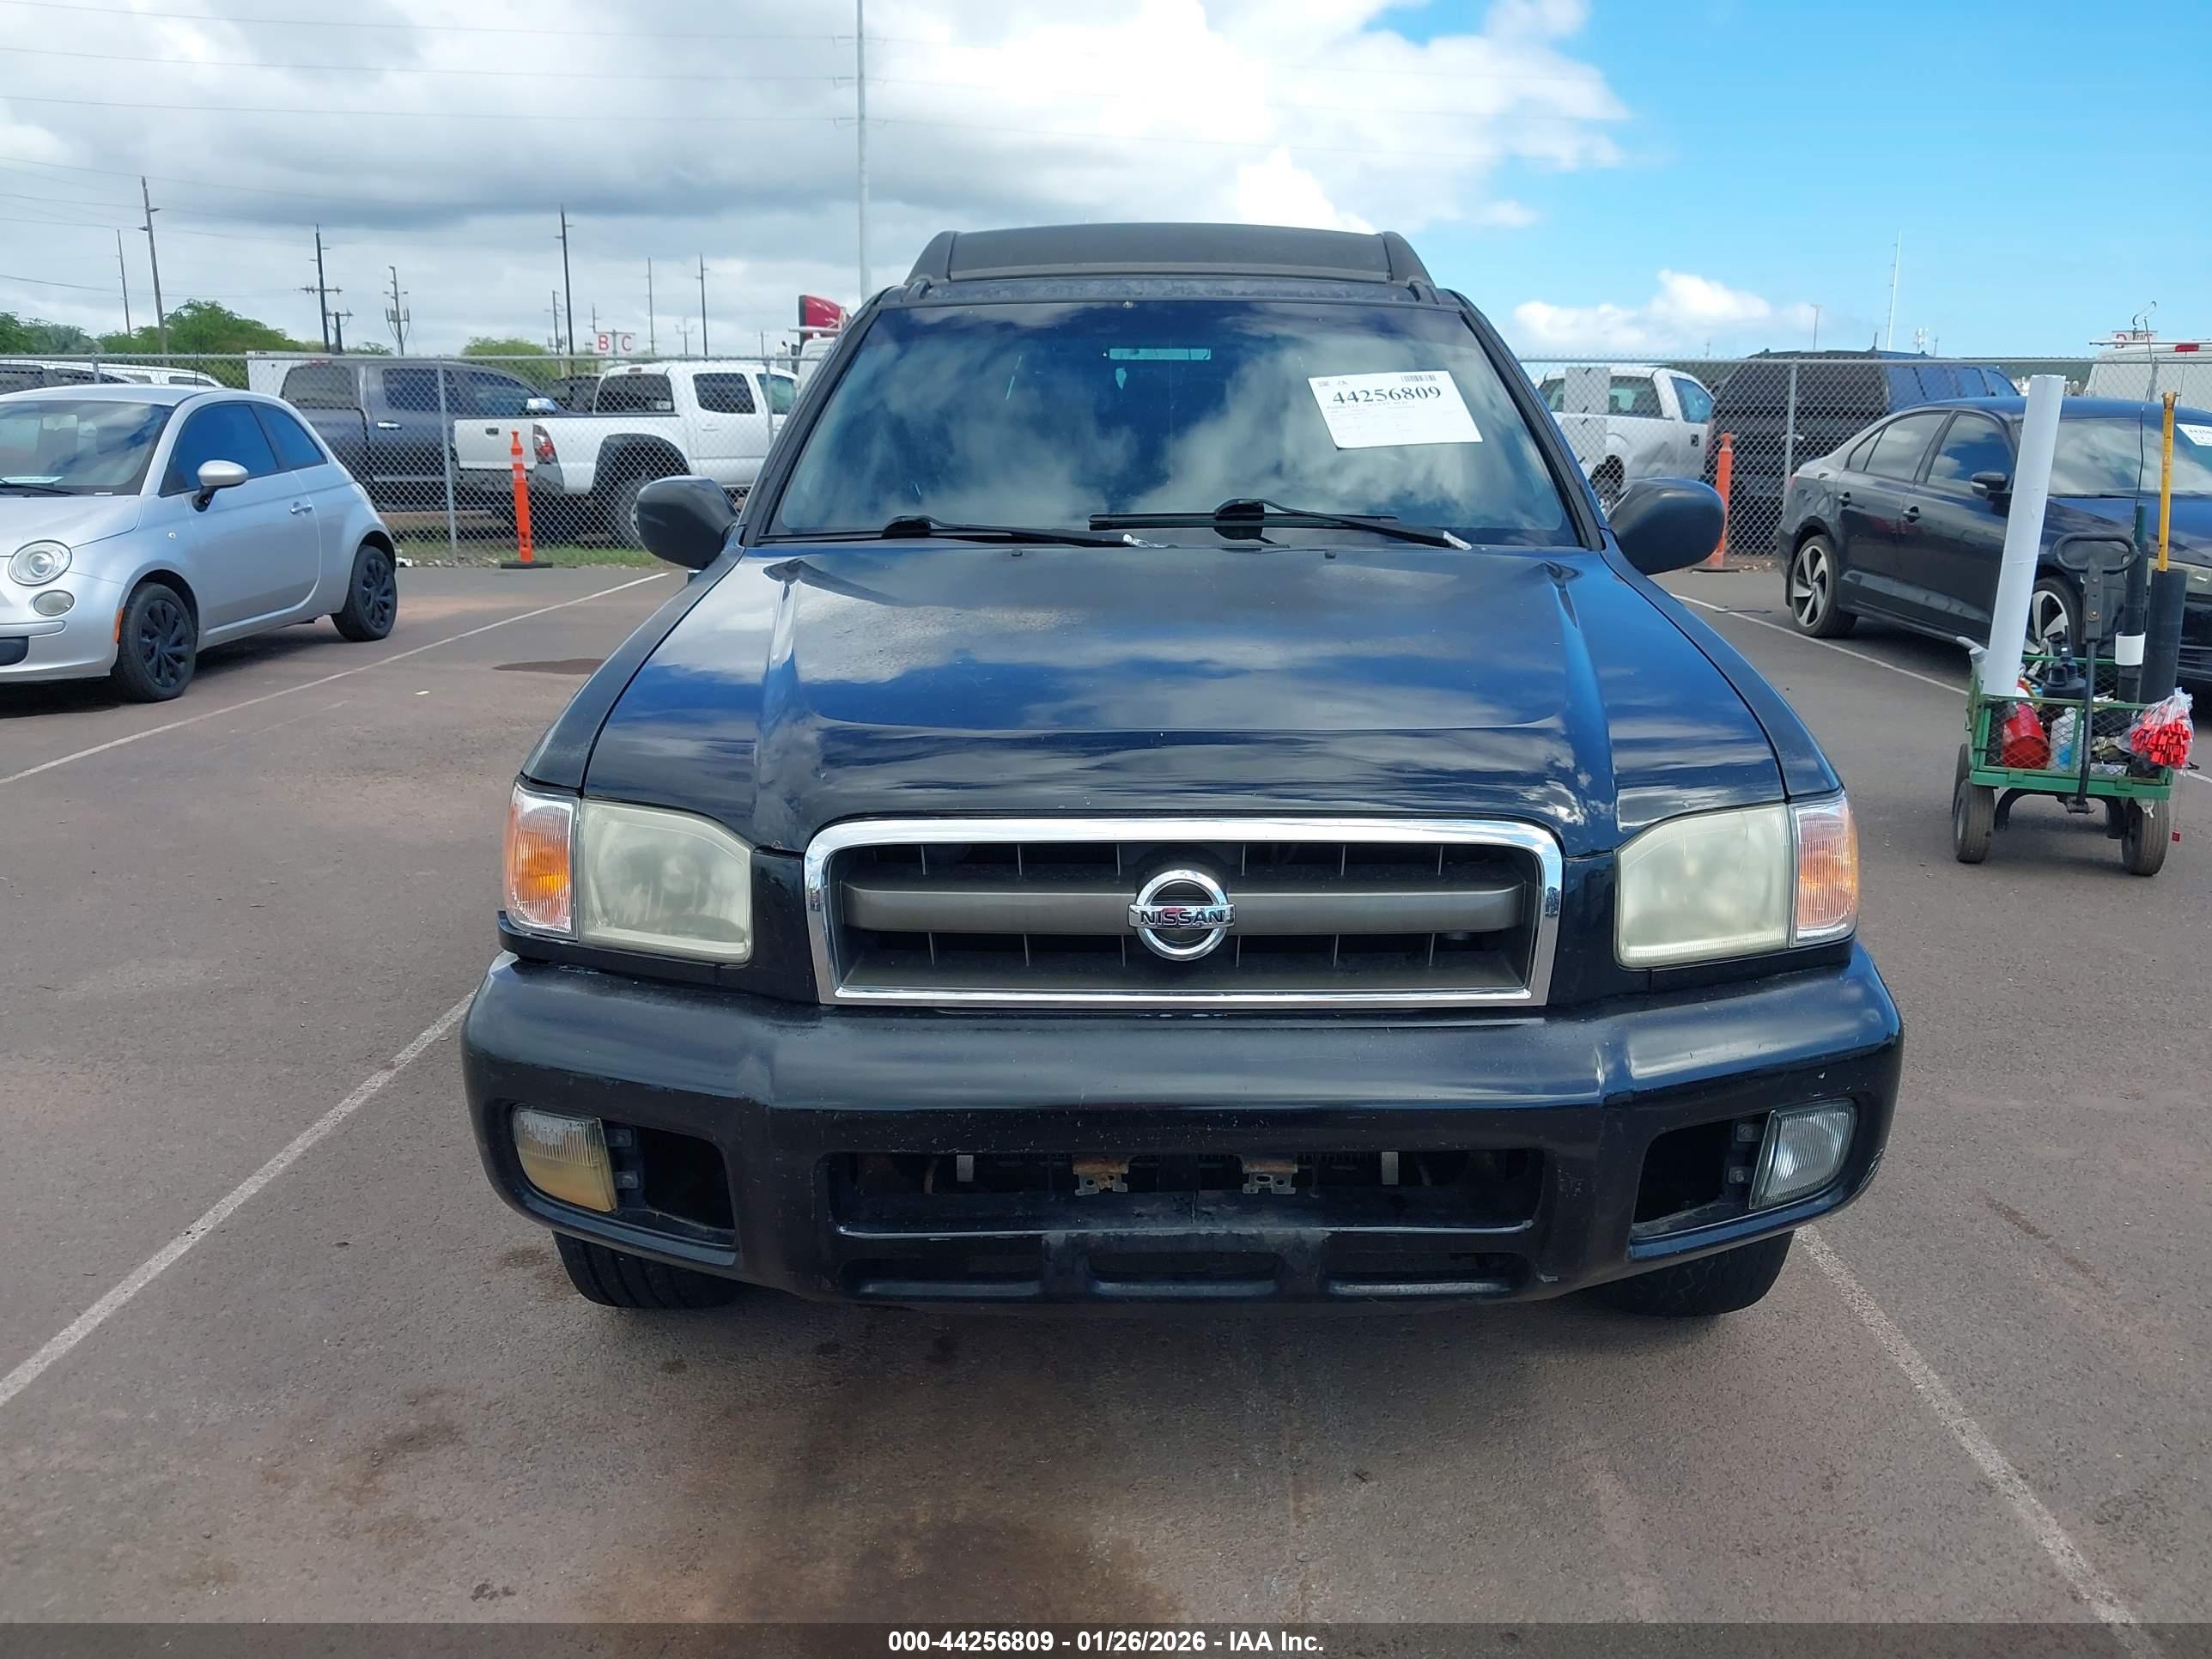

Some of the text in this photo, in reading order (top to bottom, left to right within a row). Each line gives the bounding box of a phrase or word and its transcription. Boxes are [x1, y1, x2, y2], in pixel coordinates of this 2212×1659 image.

[598, 335, 632, 351] B C
[1333, 386, 1441, 404] 44256809
[1140, 910, 1225, 925] NISSAN
